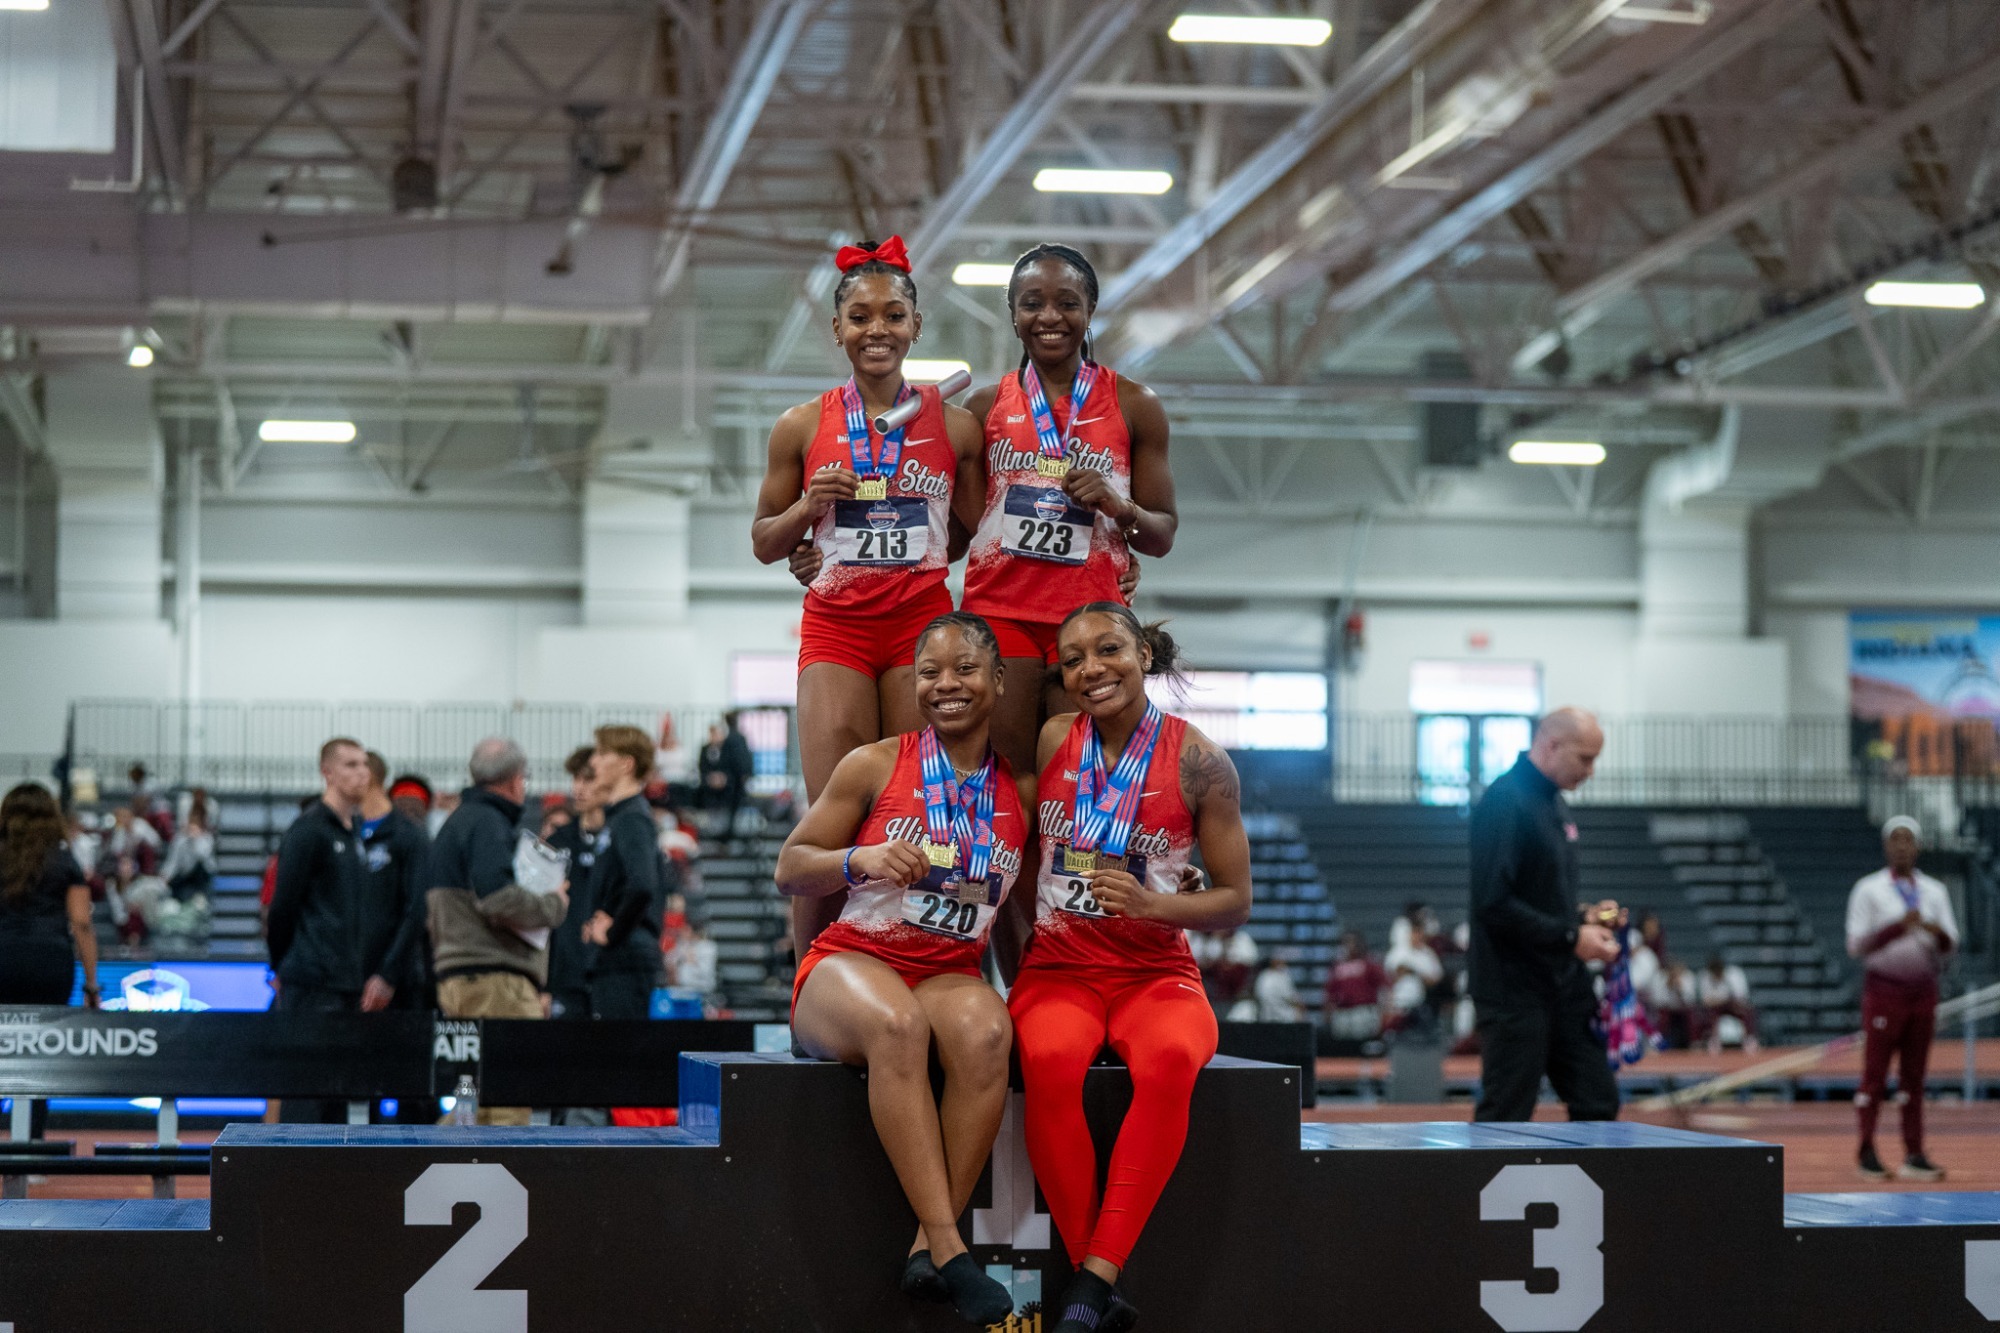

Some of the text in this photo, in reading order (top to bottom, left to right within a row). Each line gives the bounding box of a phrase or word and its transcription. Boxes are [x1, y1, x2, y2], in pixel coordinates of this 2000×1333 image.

[988, 436, 1113, 477] Illino State
[898, 458, 949, 498] State
[856, 529, 908, 559] 213
[1017, 519, 1073, 556] 223
[1063, 769, 1079, 781] VALLE
[913, 788, 925, 799] VAL
[1039, 800, 1169, 856] Illin tate
[1066, 852, 1096, 869] VALLEY
[919, 894, 978, 934] 220
[1065, 880, 1118, 916] 23
[0, 1012, 40, 1025] TATE
[0, 1027, 158, 1056] GROUNDS
[433, 1034, 480, 1062] AIR
[973, 1087, 1050, 1249] 1
[404, 1163, 528, 1333] 2
[1480, 1164, 1604, 1332] 3
